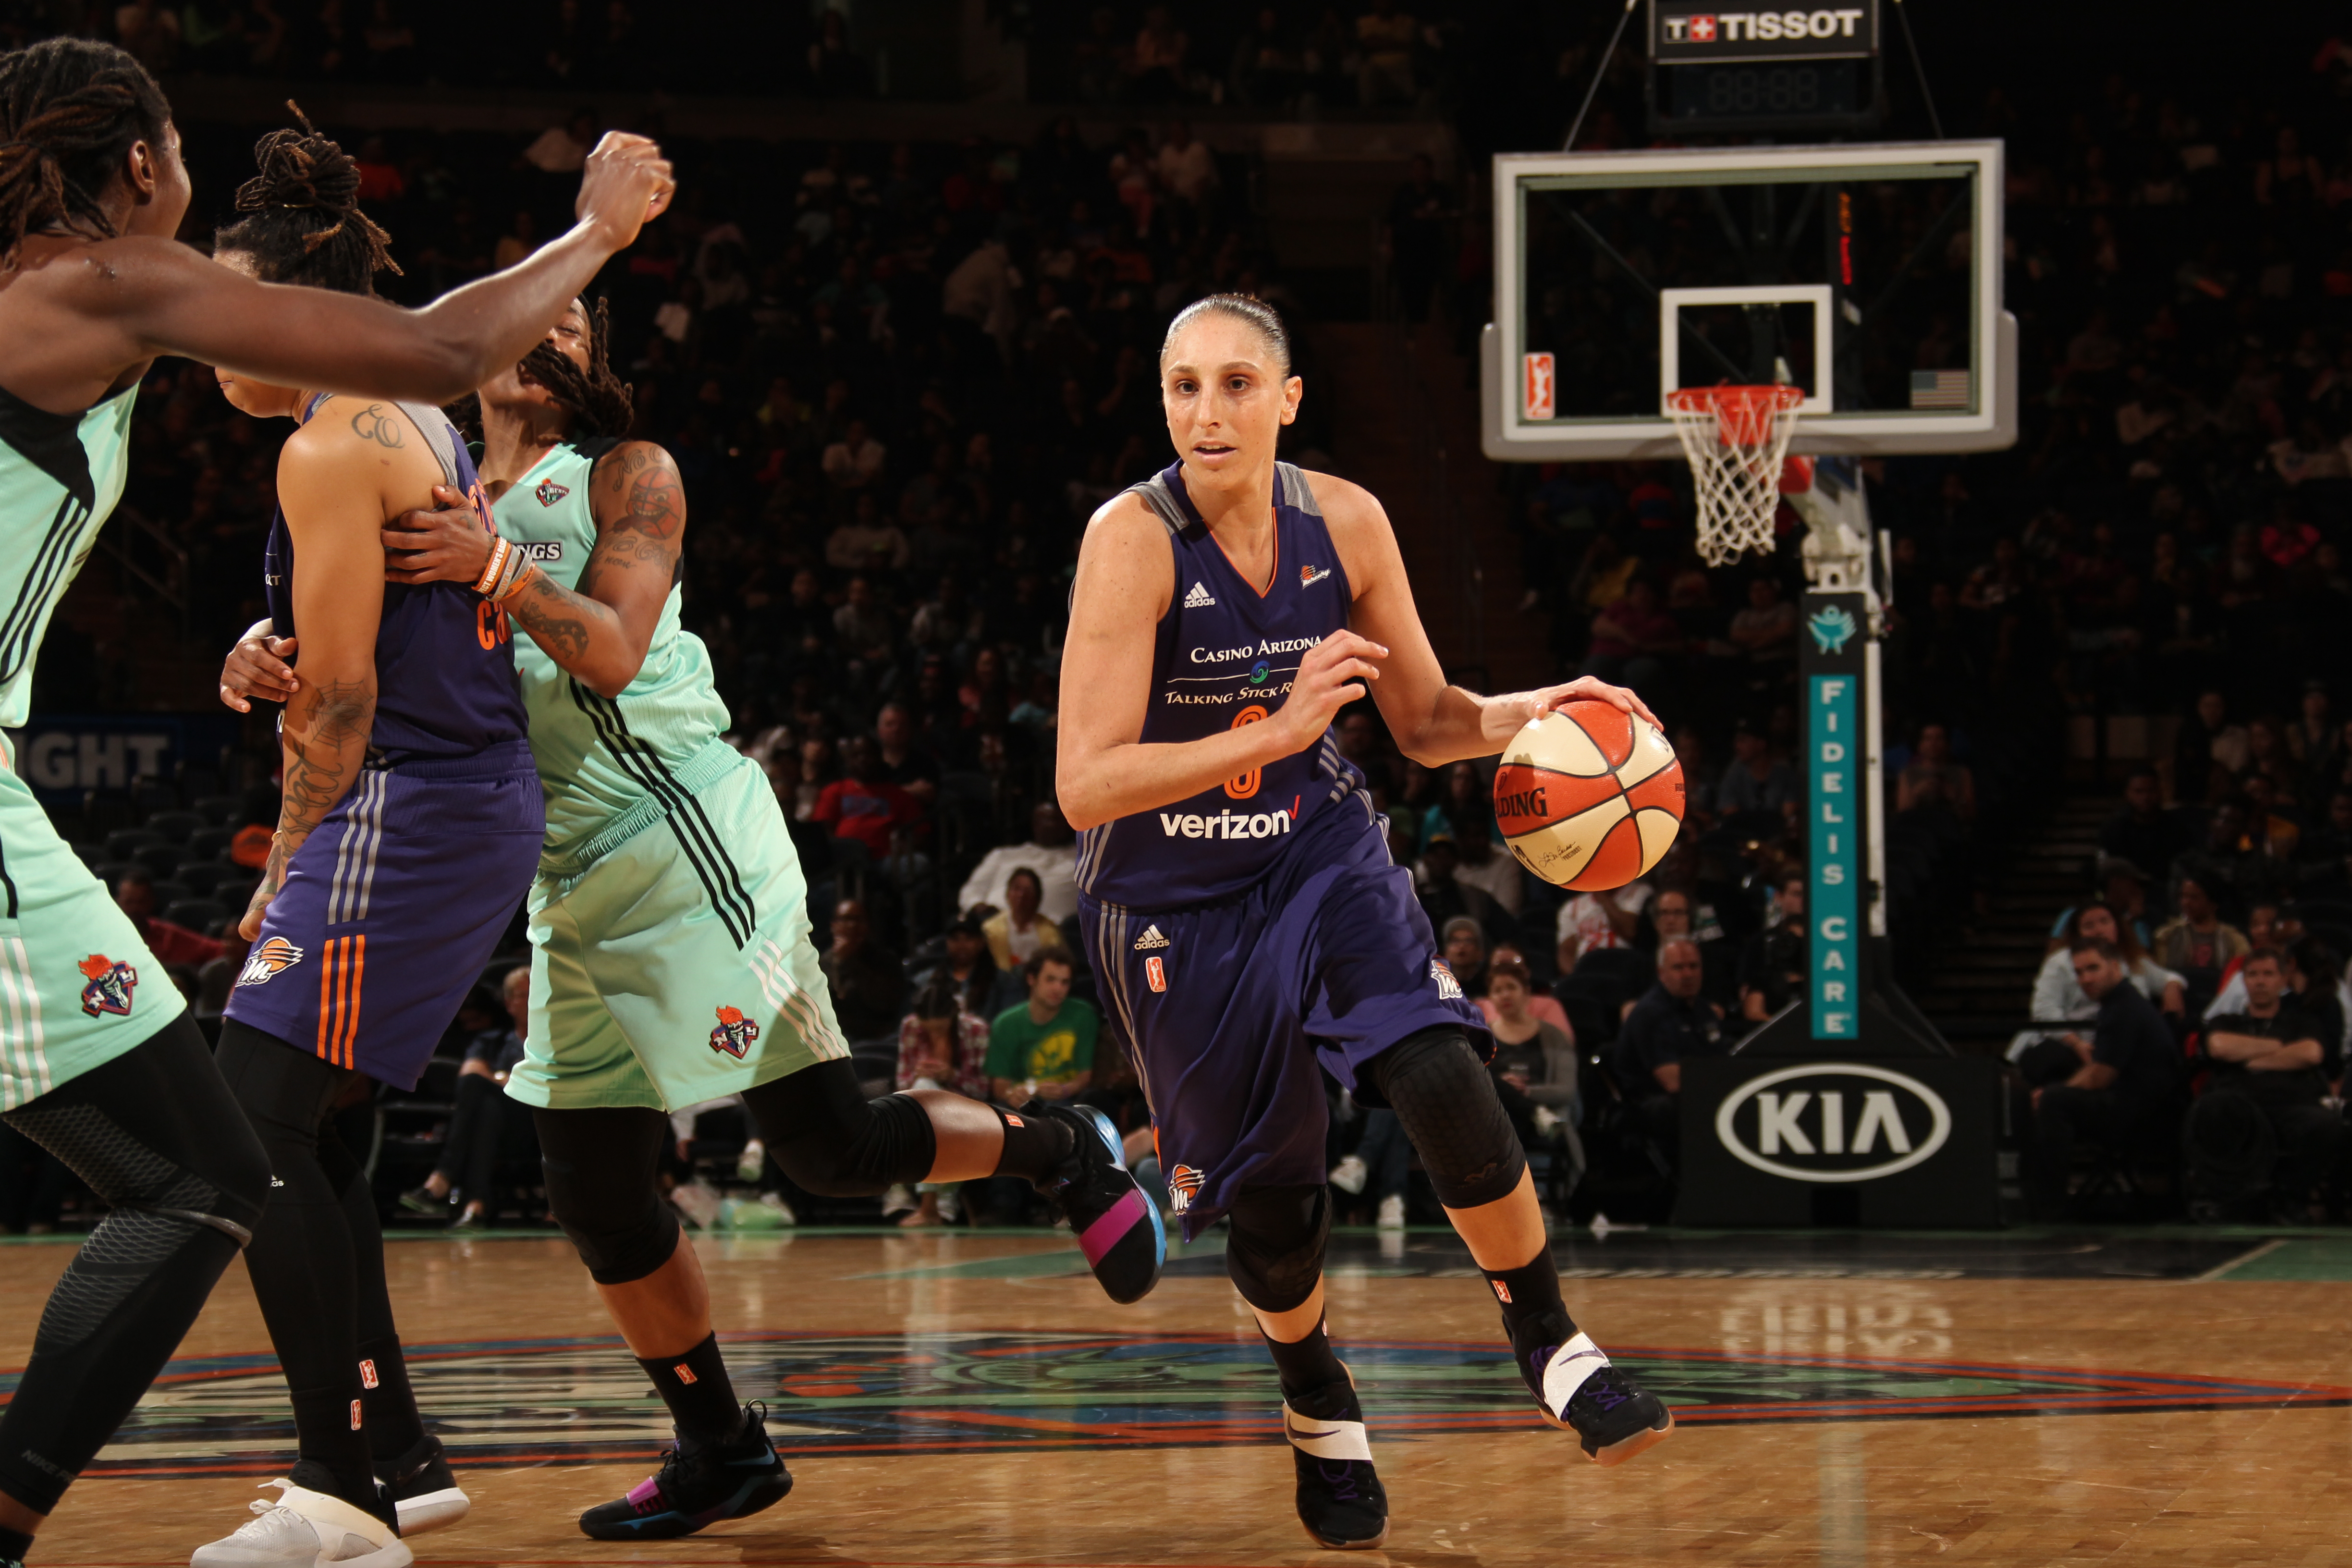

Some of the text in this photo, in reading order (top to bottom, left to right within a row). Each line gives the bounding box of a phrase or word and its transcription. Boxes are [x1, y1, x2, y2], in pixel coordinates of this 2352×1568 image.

[1718, 9, 1863, 41] TISSOT
[485, 552, 503, 583] WOMEN'S
[498, 574, 510, 594] GIVE
[506, 563, 514, 574] UP
[1184, 597, 1216, 608] adidas
[1495, 786, 1548, 818] LDING
[1159, 808, 1290, 839] verizon
[1820, 681, 1848, 1034] FIDELIS CARE
[1134, 938, 1170, 950] adidas
[1756, 1091, 1912, 1155] KIA
[21, 1449, 59, 1475] NIKE
